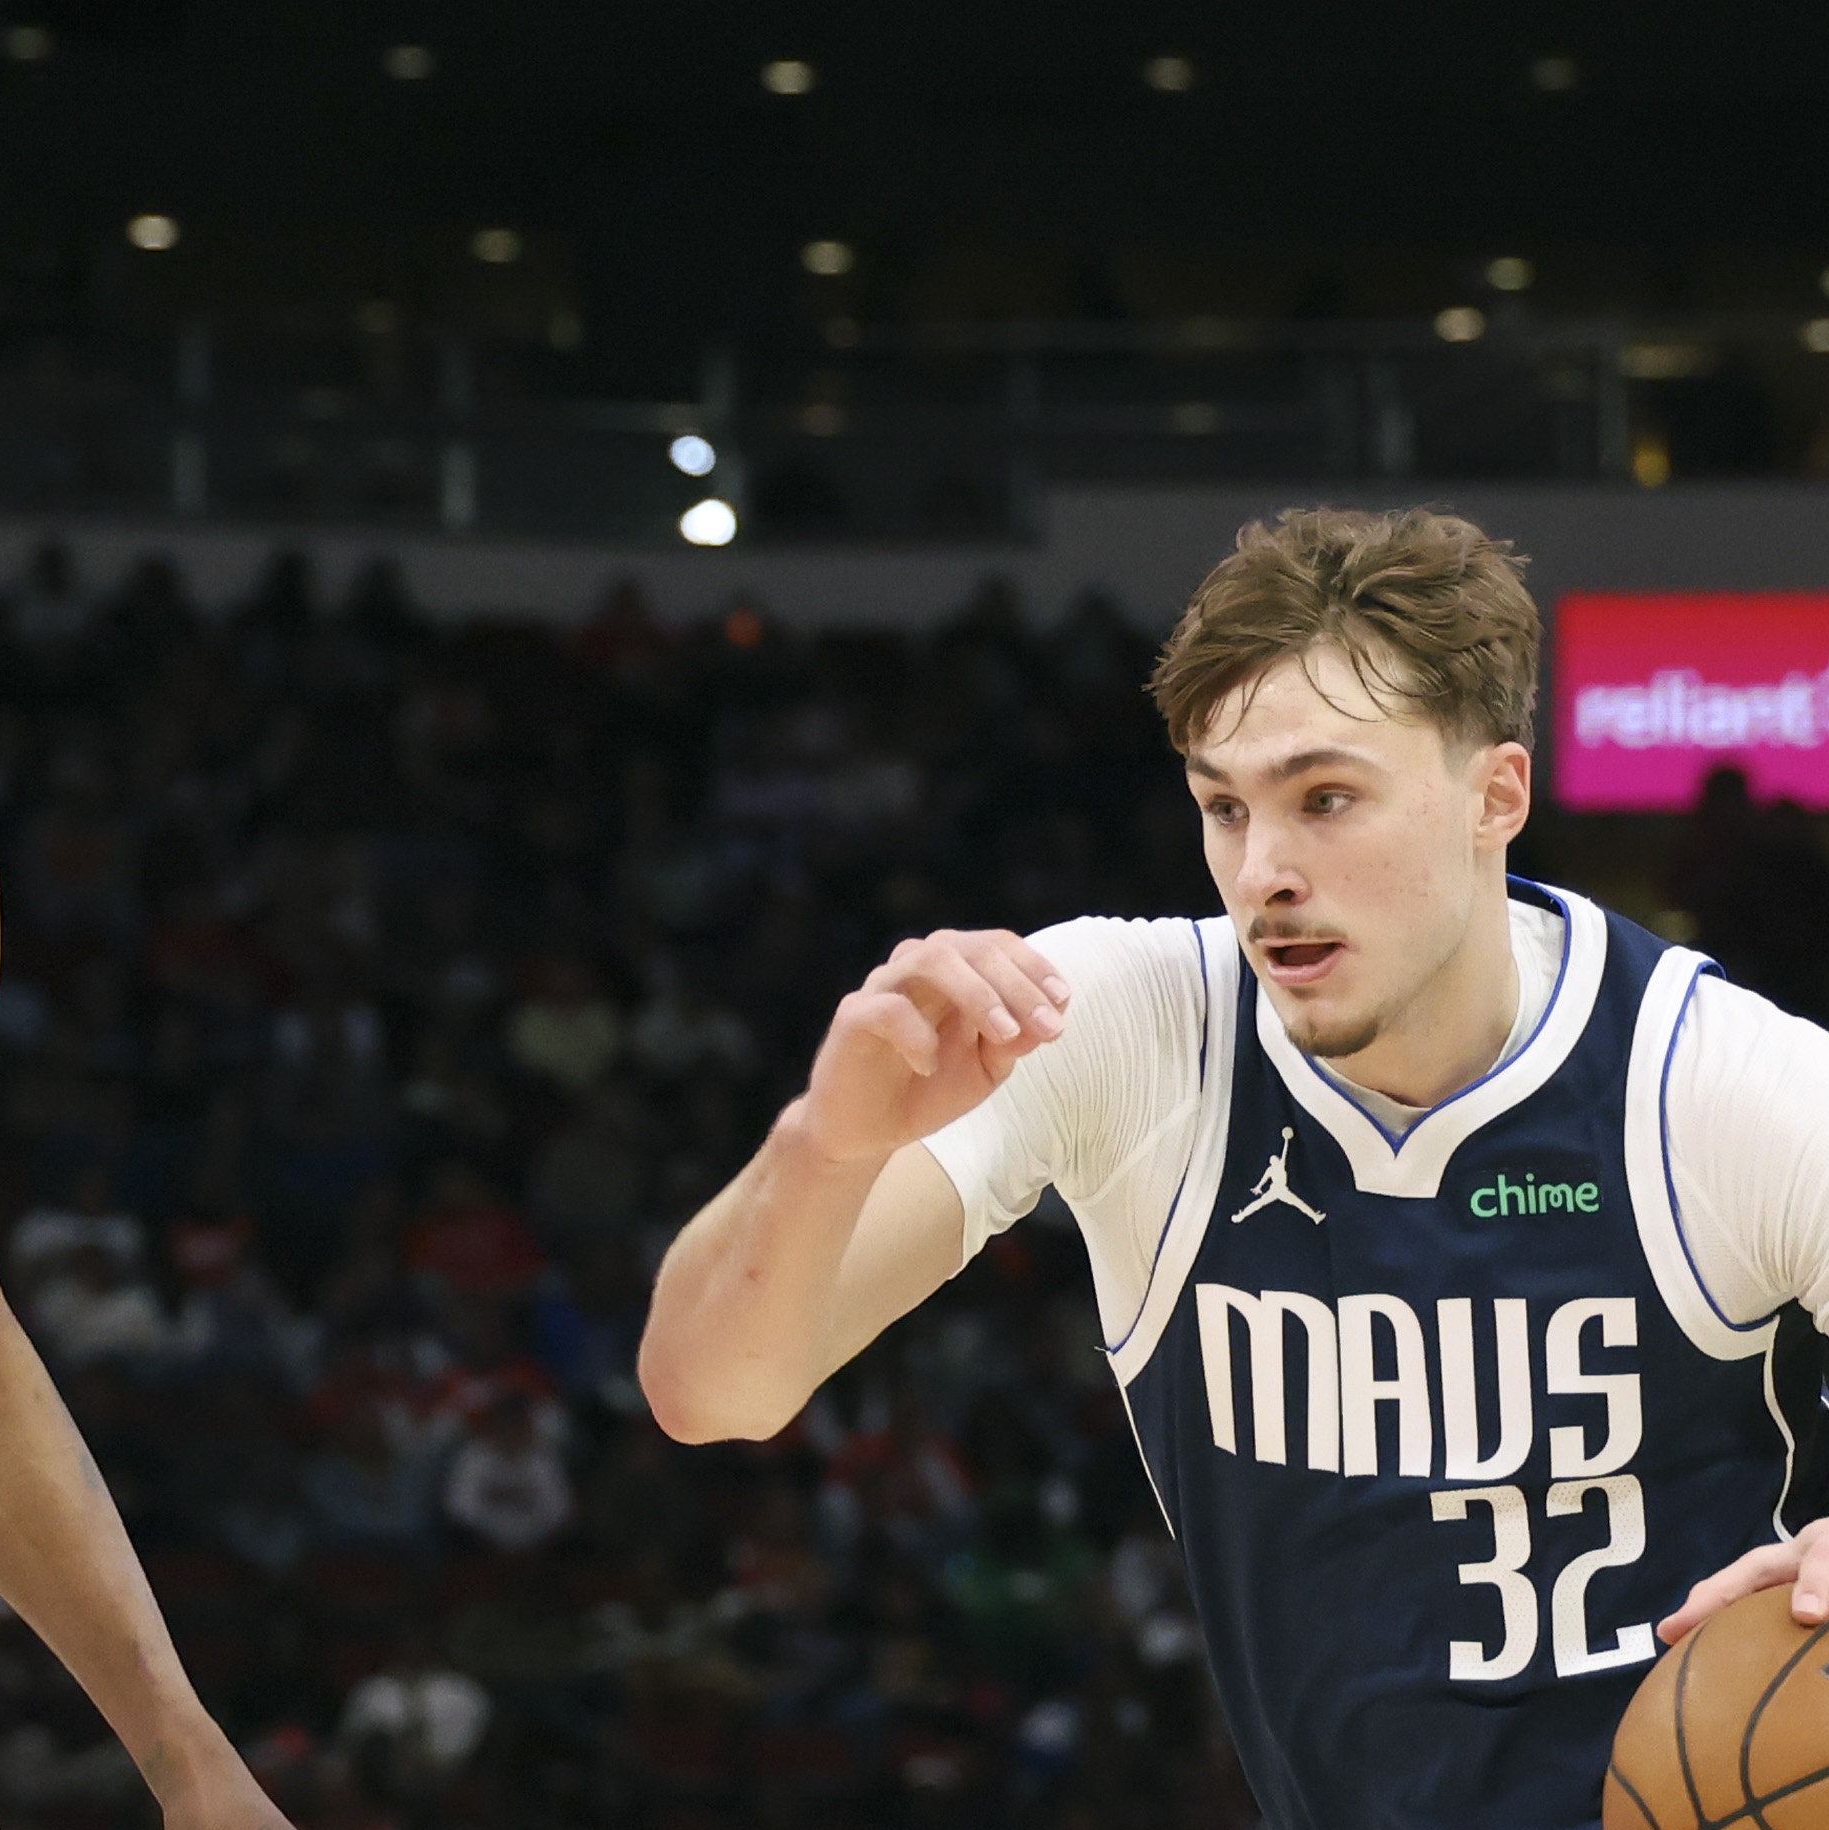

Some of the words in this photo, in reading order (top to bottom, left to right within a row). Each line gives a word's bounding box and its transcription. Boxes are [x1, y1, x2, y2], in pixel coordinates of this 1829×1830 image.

[1470, 1173, 1600, 1218] chime
[1195, 1283, 1643, 1481] MAVS
[1430, 1474, 1657, 1681] 32
